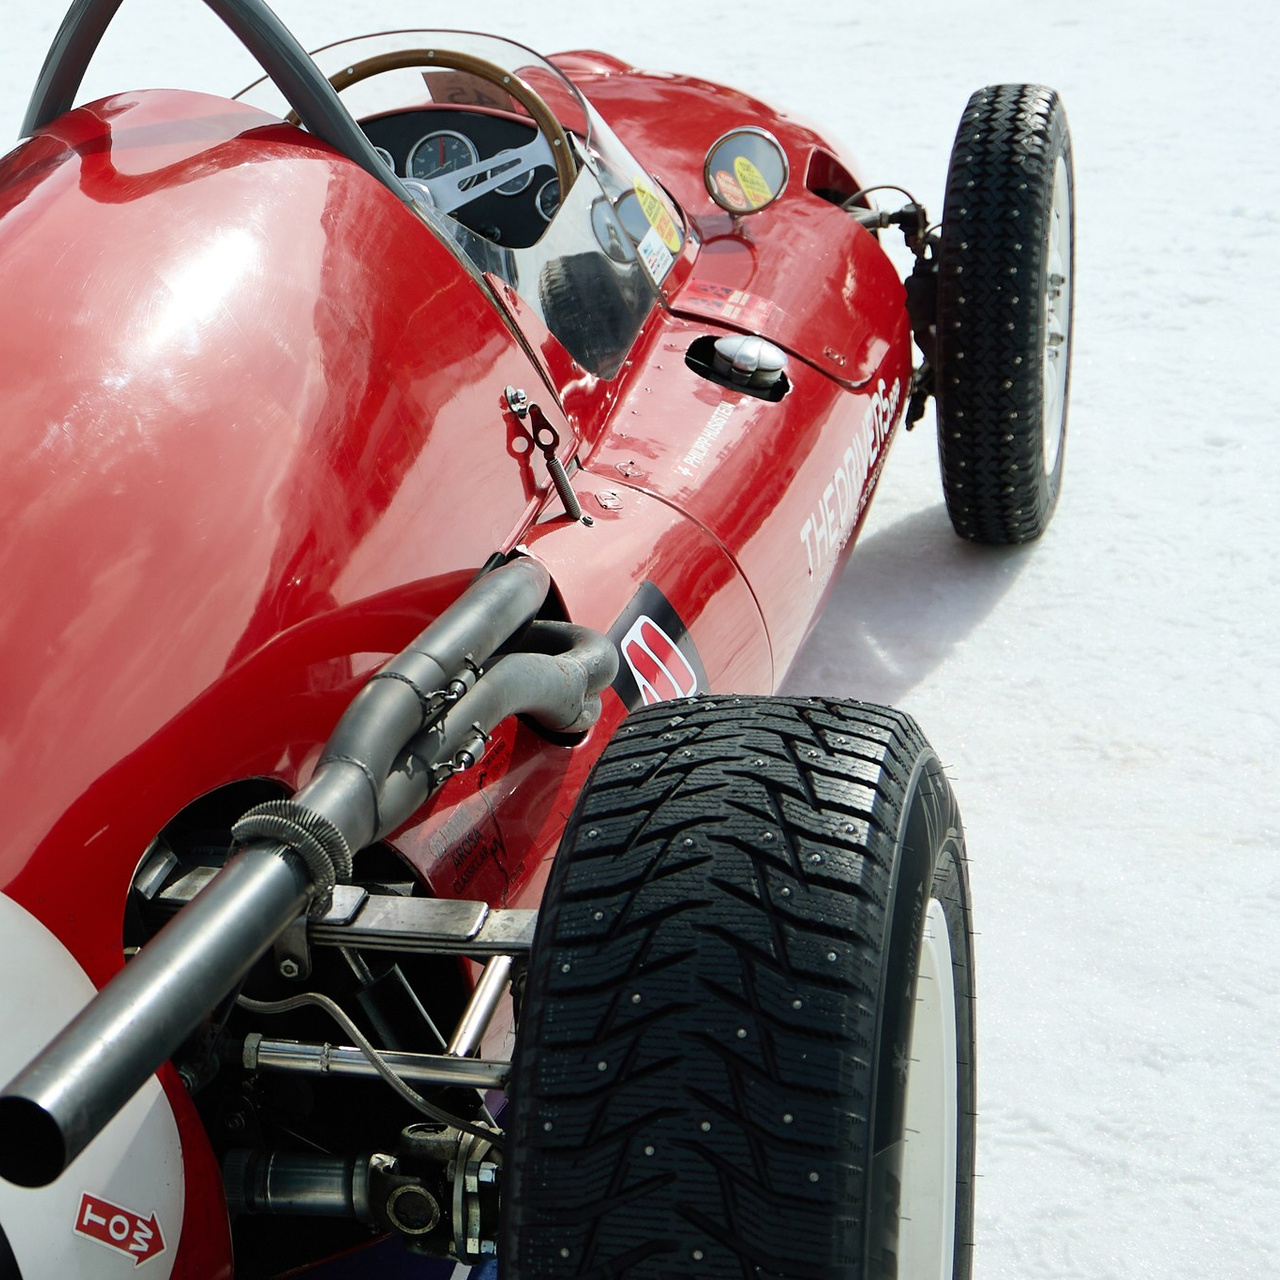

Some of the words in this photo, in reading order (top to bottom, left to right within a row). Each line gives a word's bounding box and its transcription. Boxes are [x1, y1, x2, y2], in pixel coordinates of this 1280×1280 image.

[683, 436, 712, 469] PHILIPP
[451, 827, 484, 868] AROSA
[83, 1204, 153, 1252] TOW
